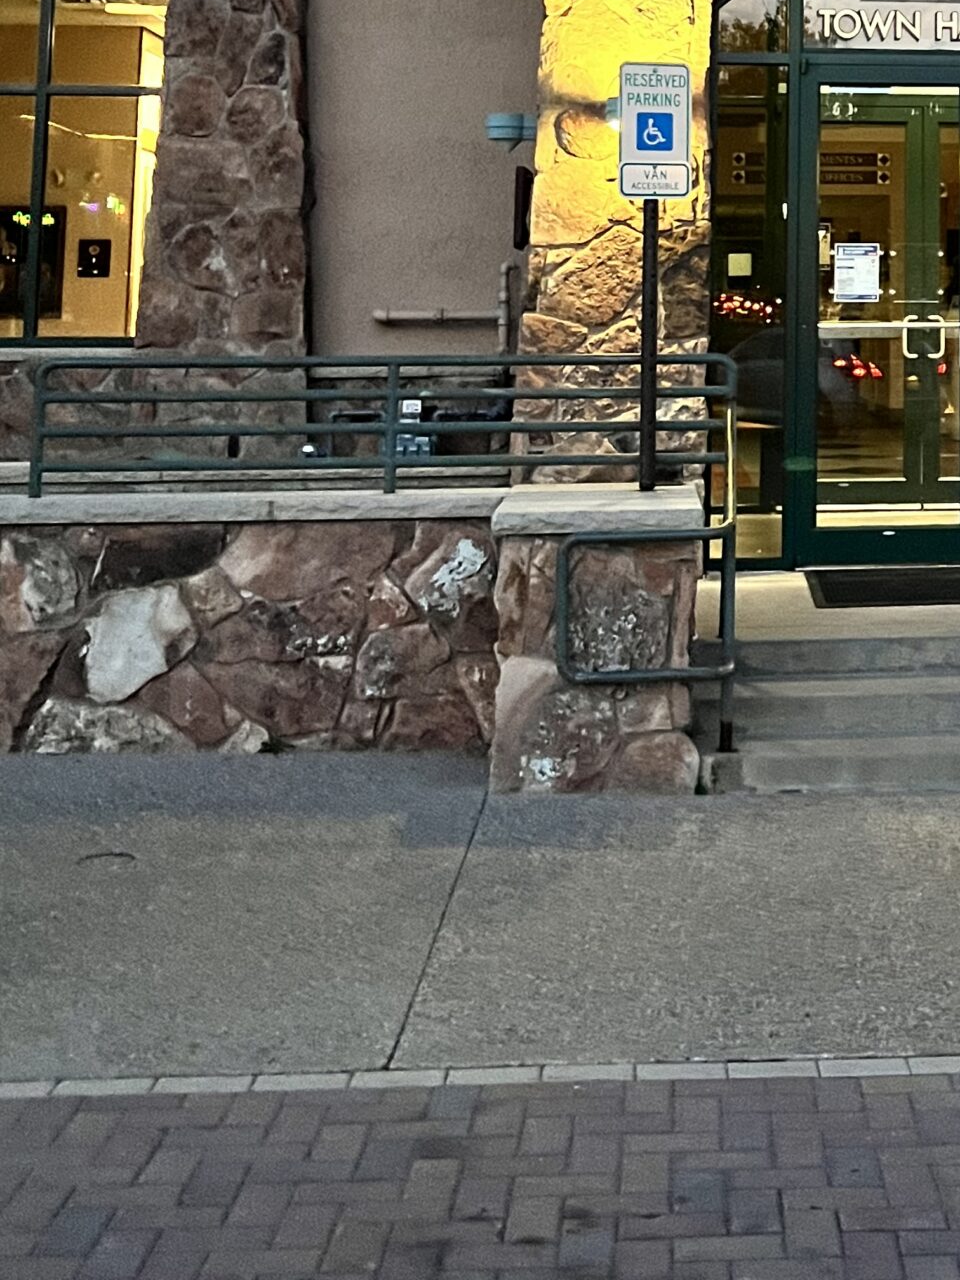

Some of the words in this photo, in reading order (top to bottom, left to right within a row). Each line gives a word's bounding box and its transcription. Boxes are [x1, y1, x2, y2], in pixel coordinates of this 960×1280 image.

[818, 8, 922, 43] TOWN
[624, 73, 686, 88] RESERVED
[626, 92, 681, 107] PARKING
[644, 170, 667, 180] VAN
[631, 182, 680, 191] ACCESSIBLE
